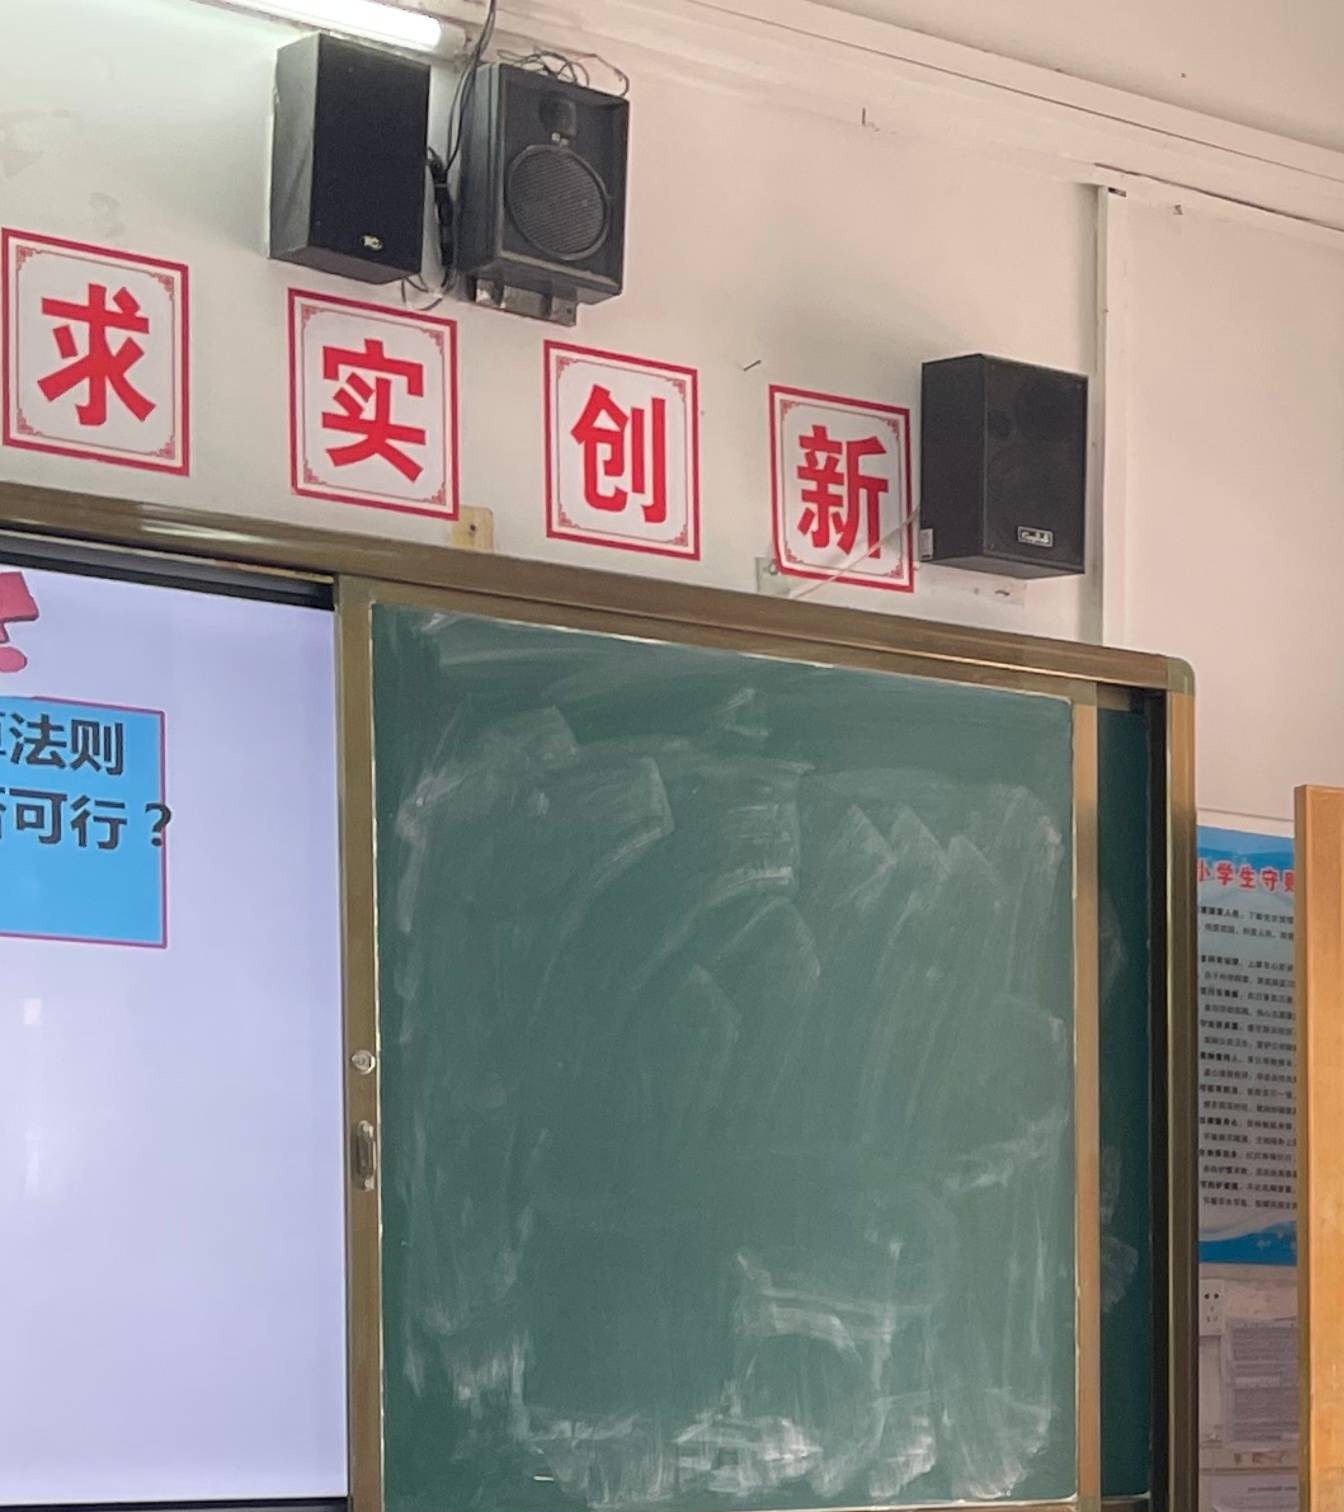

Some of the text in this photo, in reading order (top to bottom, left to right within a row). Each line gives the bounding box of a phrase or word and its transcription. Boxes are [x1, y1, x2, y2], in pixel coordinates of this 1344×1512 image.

[37, 282, 889, 561] 求 实 创 新
[0, 711, 125, 776] 法则
